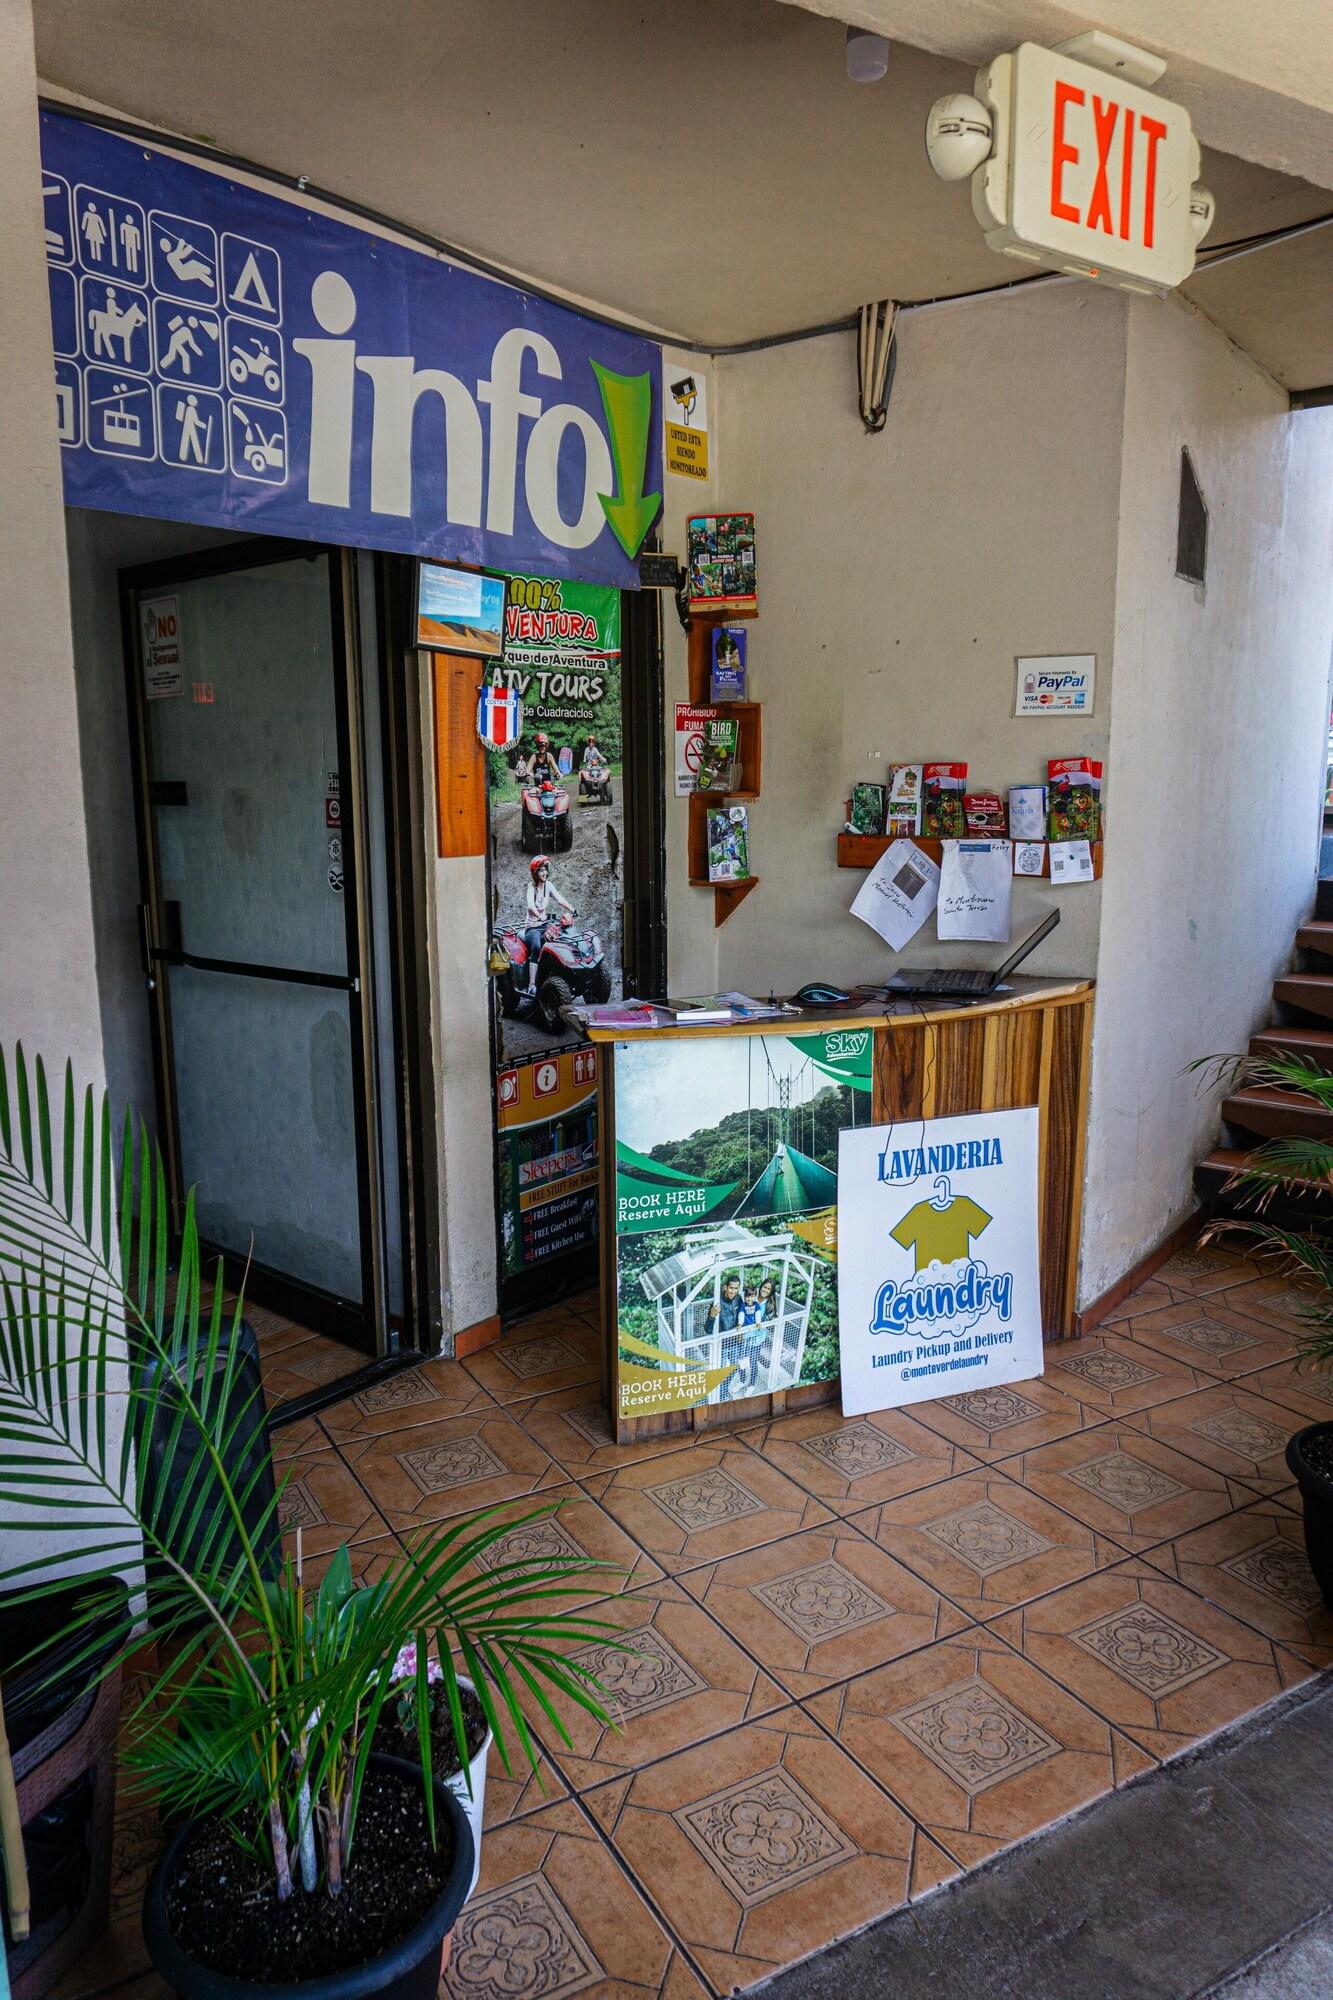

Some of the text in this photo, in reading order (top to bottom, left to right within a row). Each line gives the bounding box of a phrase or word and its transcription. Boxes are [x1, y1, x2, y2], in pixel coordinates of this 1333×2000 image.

[1050, 80, 1167, 248] EXIT
[293, 271, 612, 549] info
[671, 429, 688, 442] USTED
[676, 446, 695, 460] SIENDO
[669, 458, 706, 478] MONITOREADO
[509, 577, 562, 611] 00%
[157, 615, 177, 638] NO
[506, 606, 598, 641] VENTURA
[534, 652, 551, 664] de
[552, 654, 606, 669] Aventura
[492, 667, 604, 702] ATV TOURS
[1038, 675, 1085, 691] PayPal
[536, 706, 594, 719] Cuadraciclos
[711, 722, 732, 735] BIRD
[825, 1033, 869, 1055] Sky
[522, 1152, 577, 1184] Sleepers
[877, 1138, 1003, 1181] LAVANDERIA
[529, 1188, 545, 1204] FREE
[618, 1189, 706, 1210] BOOK HERE
[533, 1197, 578, 1221] FREE Breakfast
[618, 1201, 706, 1222] Reserve Aquí
[534, 1225, 550, 1240] FREE
[550, 1220, 567, 1232] Guest
[534, 1232, 585, 1258] FREE Kitchen Use
[872, 1266, 1012, 1333] Laundry
[872, 1330, 1014, 1368] Laundry Pickup and Delivery
[901, 1353, 988, 1381] @monteverdelaundry
[621, 1372, 706, 1395] BOOK HERE
[622, 1384, 706, 1407] Reserve Aquí
